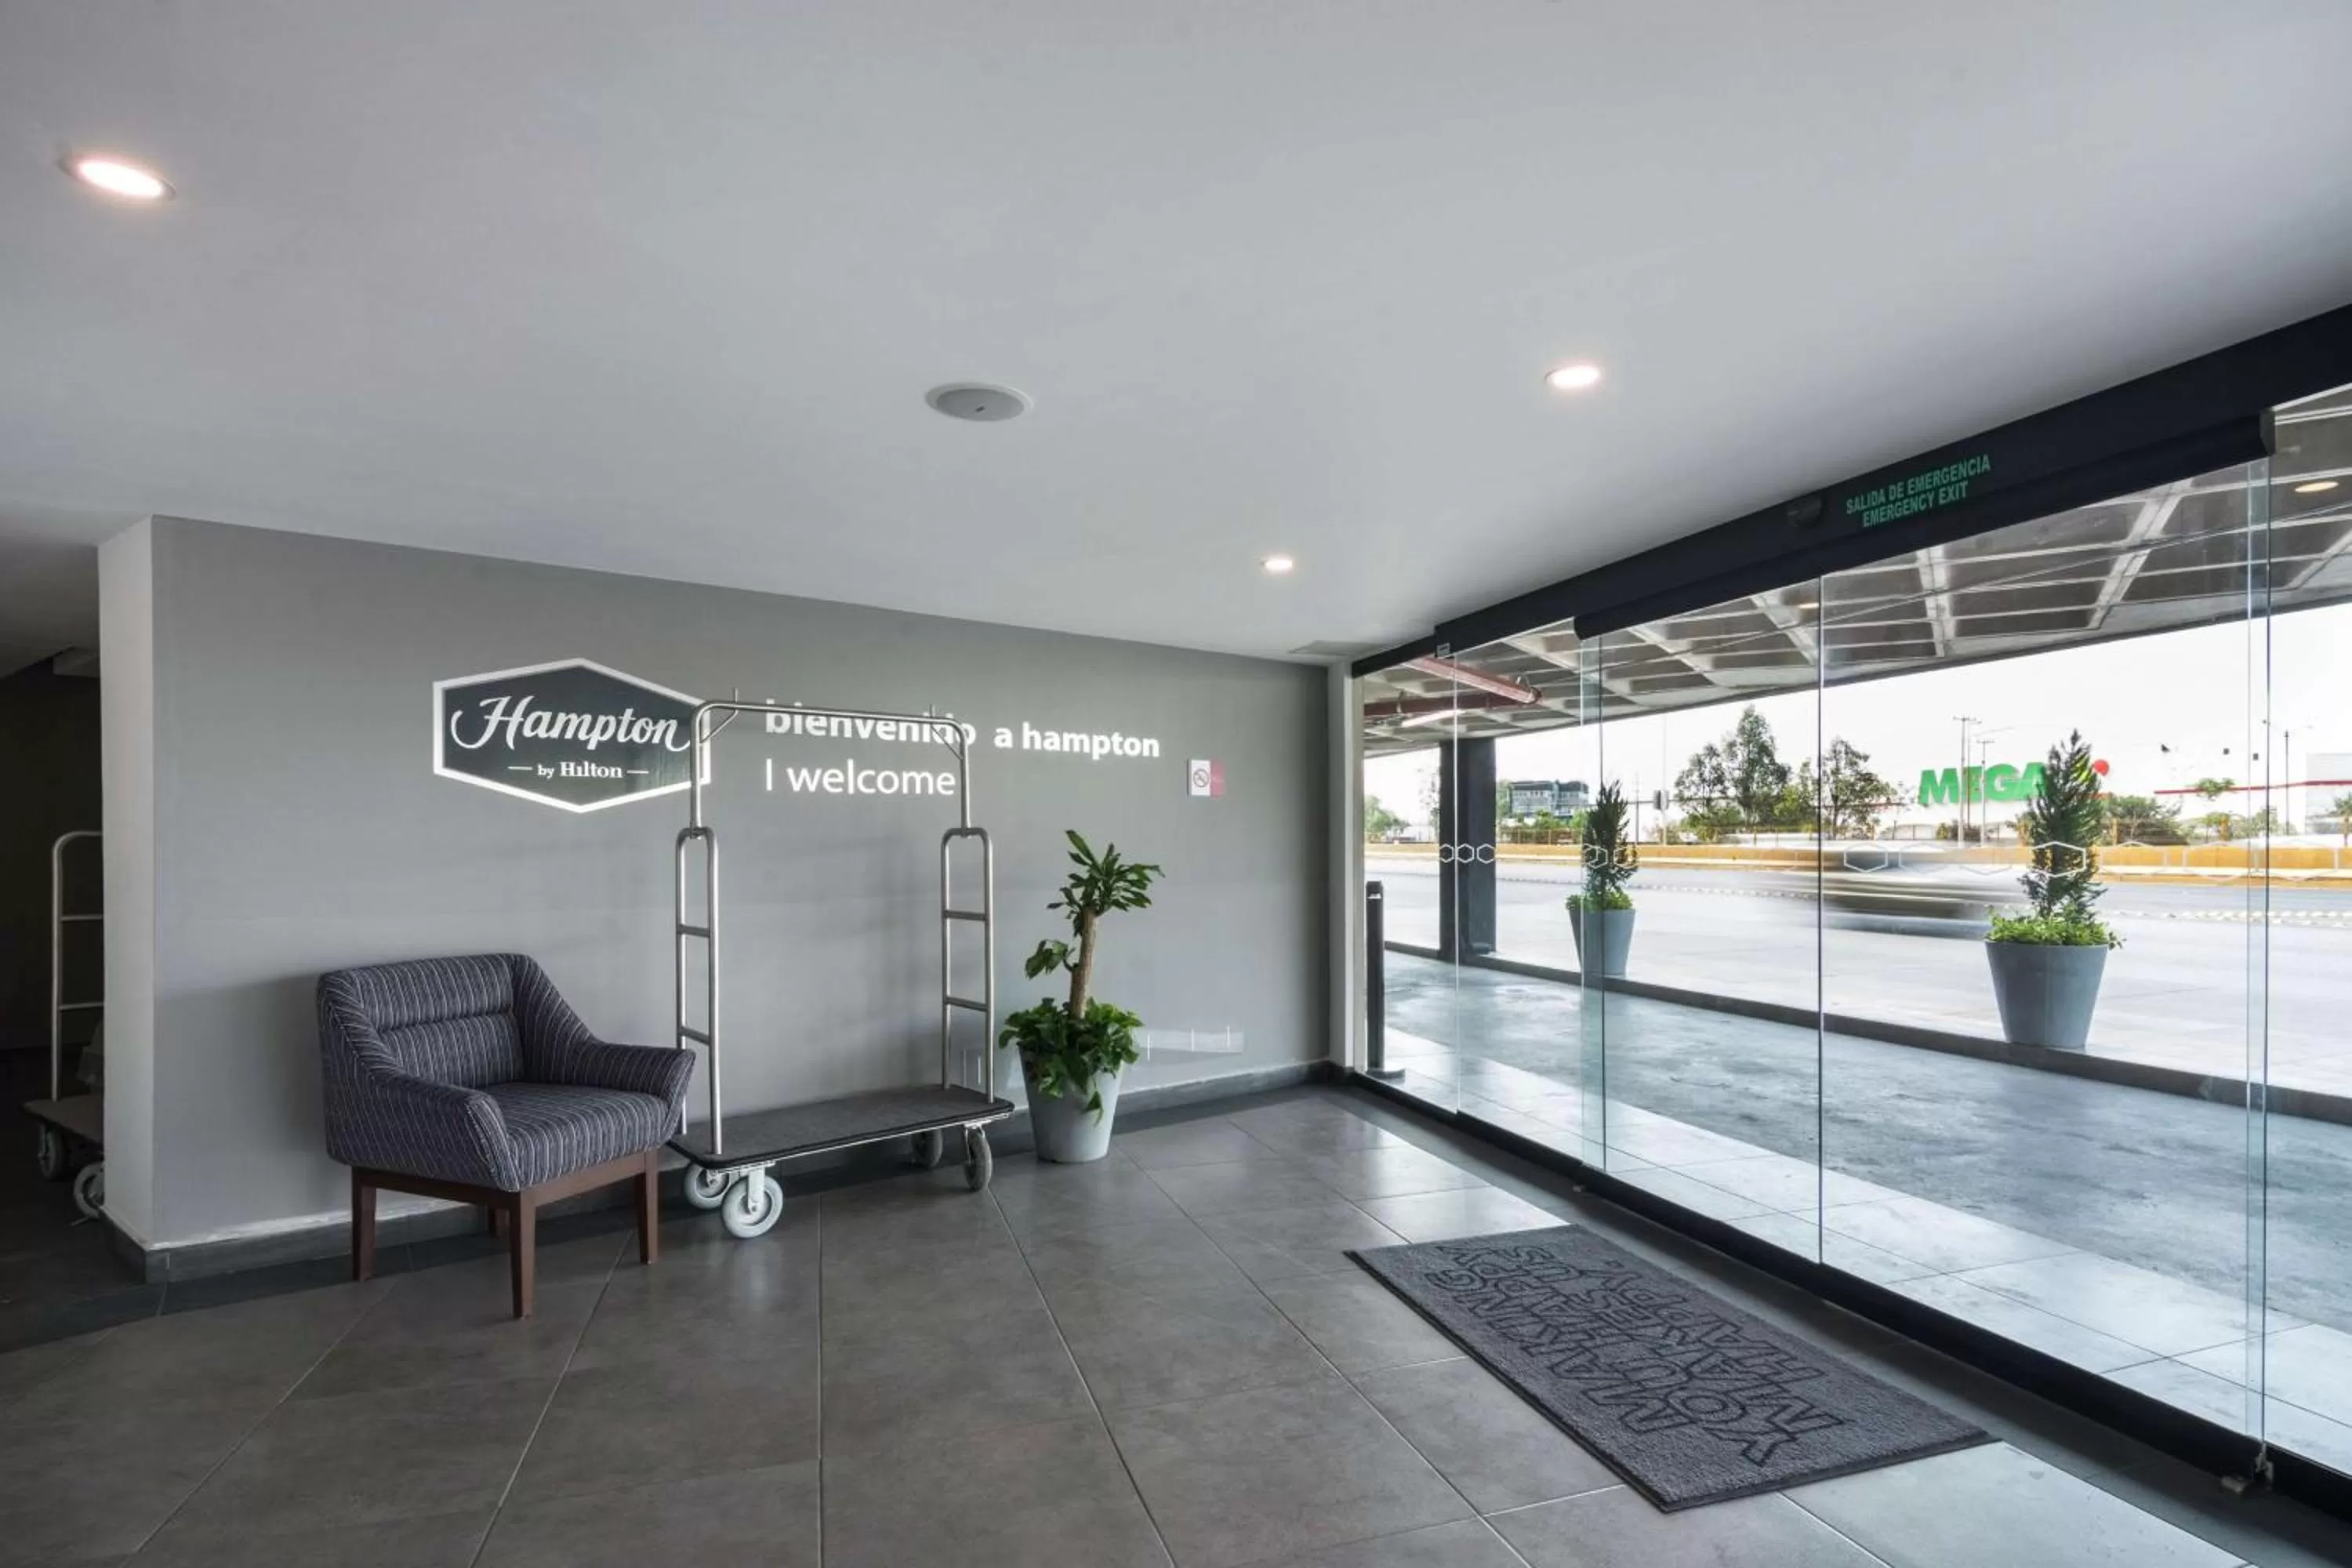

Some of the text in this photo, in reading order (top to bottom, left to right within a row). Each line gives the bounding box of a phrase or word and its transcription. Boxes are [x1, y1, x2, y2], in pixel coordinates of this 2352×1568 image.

[1846, 454, 1991, 514] SALIDA DE EMERGENCIA
[1863, 481, 1969, 528] EMERGENCY EXIT
[451, 695, 691, 752] Hampton
[993, 719, 1014, 749] a
[1022, 720, 1160, 760] hampton
[537, 761, 623, 779] by Hilton
[786, 758, 956, 795] welcome
[1423, 1271, 1696, 1434] MAKING
[1436, 1247, 1798, 1466] YOU HAPPY
[1570, 1288, 1845, 1434] MAKES
